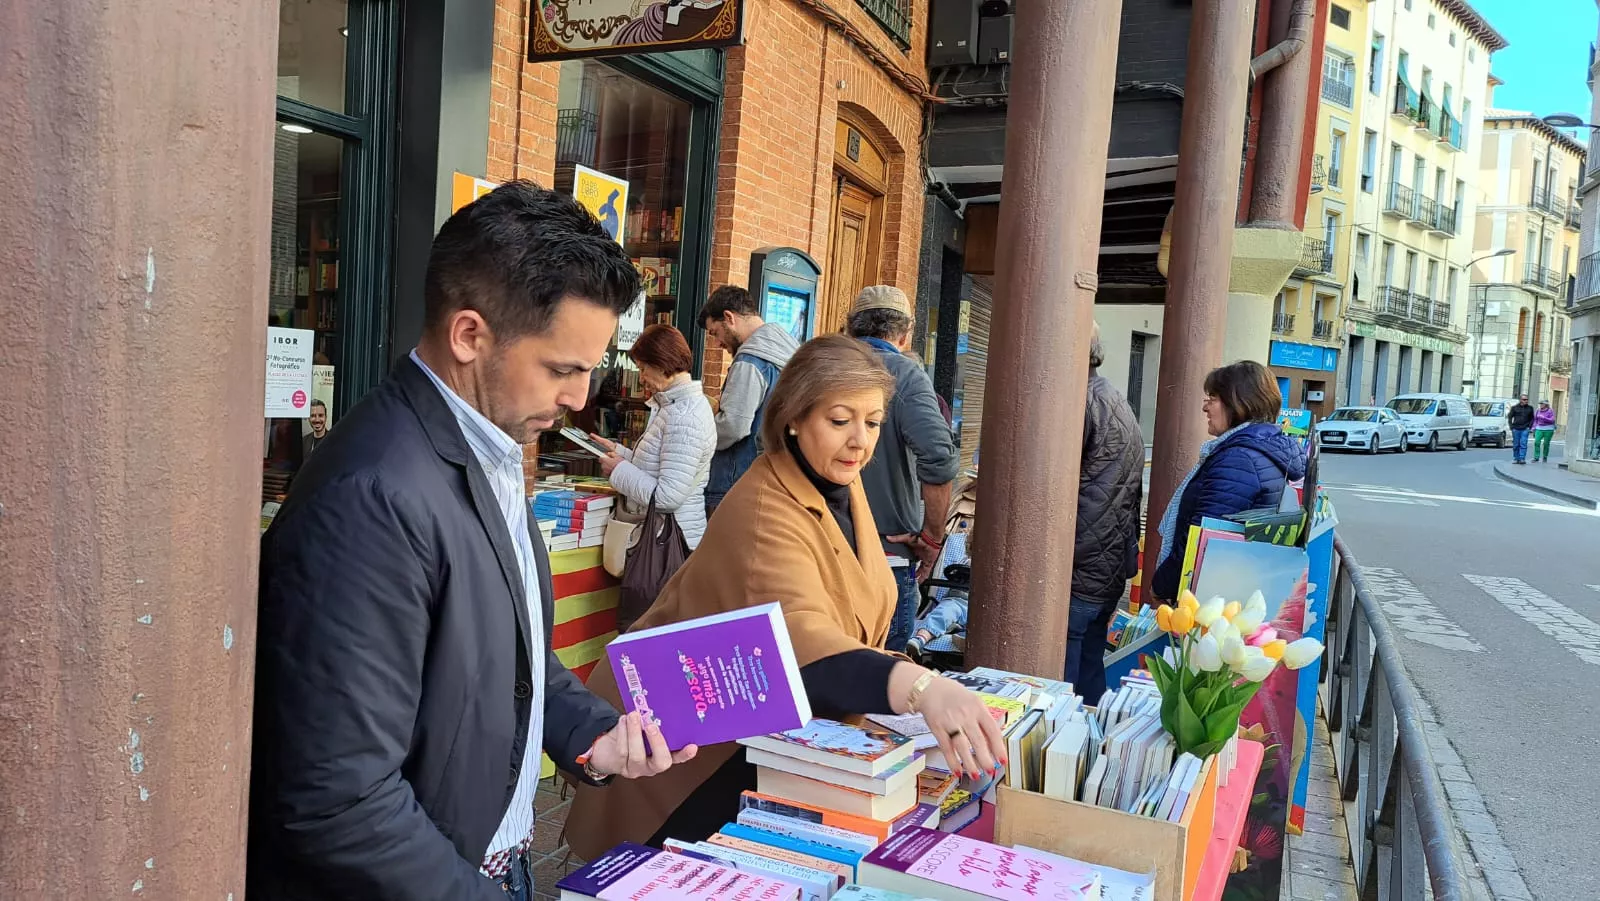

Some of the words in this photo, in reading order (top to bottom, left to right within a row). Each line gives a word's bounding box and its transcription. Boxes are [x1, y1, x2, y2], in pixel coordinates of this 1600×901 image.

[273, 336, 298, 345] IBOR
[697, 663, 709, 679] algo
[687, 677, 708, 712] sexo
[702, 679, 717, 705] más
[644, 854, 675, 872] dolly
[917, 849, 951, 876] SCORE
[655, 874, 668, 884] el
[750, 877, 765, 888] sé
[628, 882, 656, 901] amor
[760, 882, 785, 900] todo
